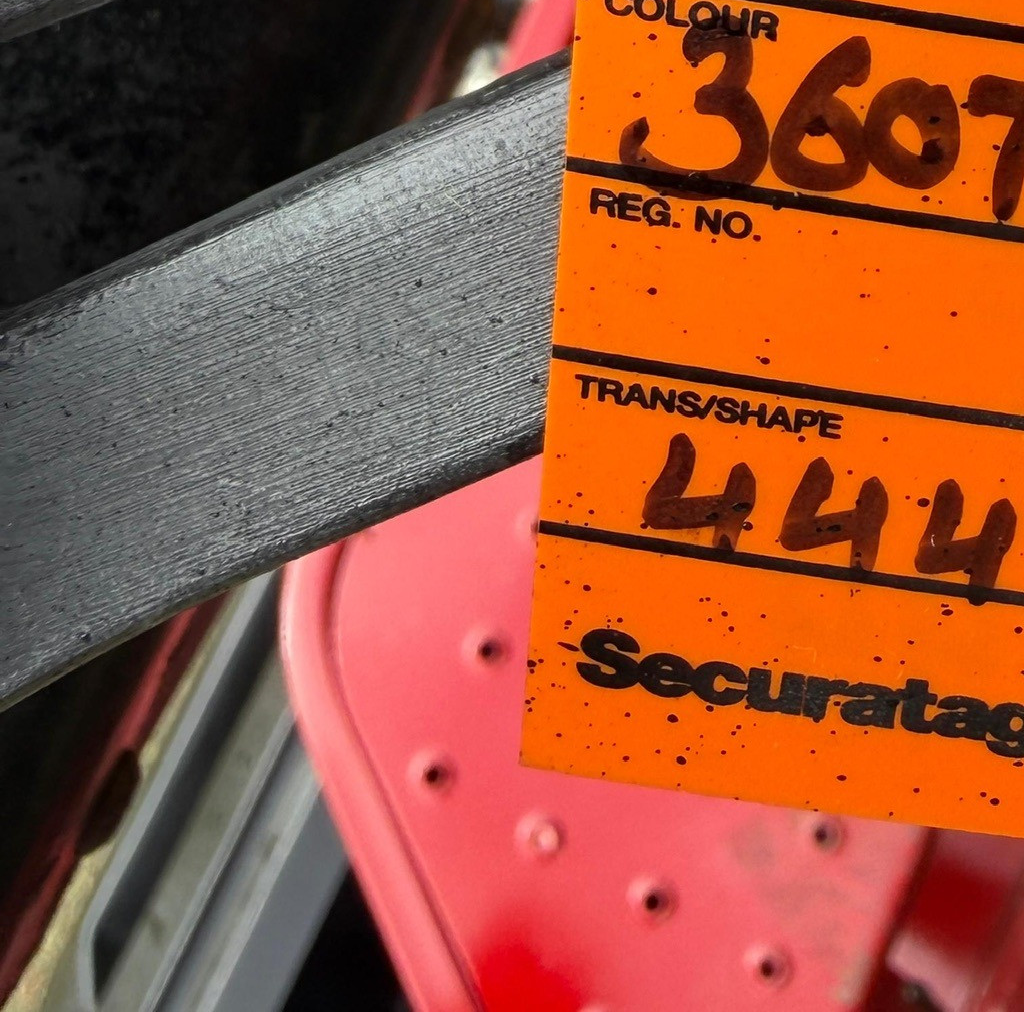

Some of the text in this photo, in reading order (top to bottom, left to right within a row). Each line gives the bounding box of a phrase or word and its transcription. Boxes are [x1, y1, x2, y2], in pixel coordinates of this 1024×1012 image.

[588, 187, 762, 243] REG. NO.
[575, 373, 844, 440] TRANS/SHAPE
[640, 432, 1017, 605] 444
